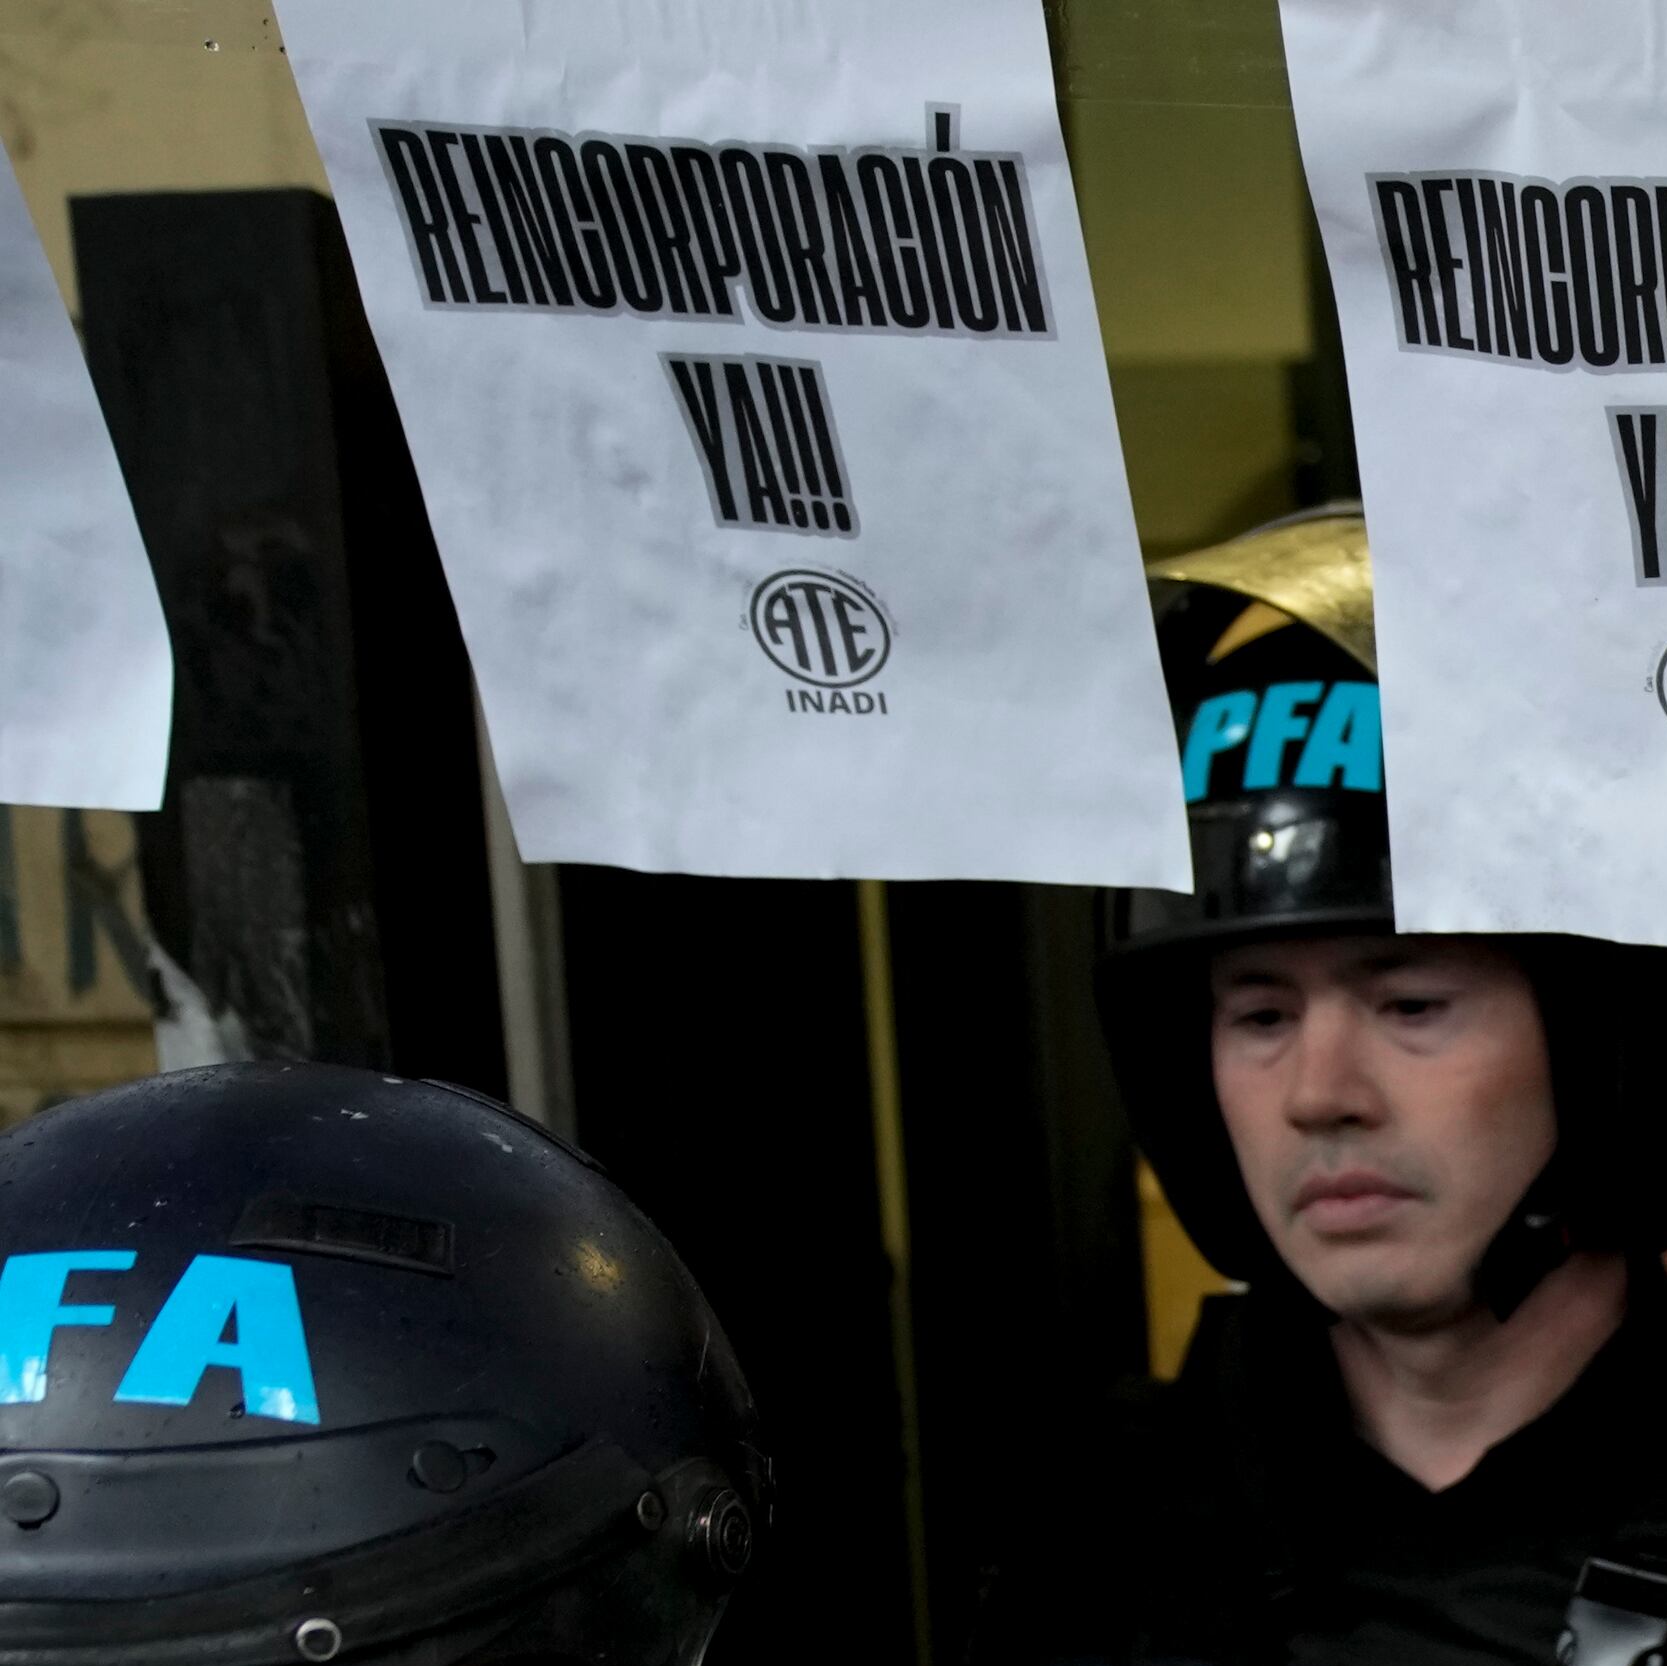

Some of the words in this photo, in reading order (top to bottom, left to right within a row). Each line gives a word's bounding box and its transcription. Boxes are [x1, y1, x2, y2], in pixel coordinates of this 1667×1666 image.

[384, 112, 1048, 334] REINCORPORACIÓN
[669, 359, 852, 533] YA!!!
[764, 581, 876, 677] ATE
[785, 689, 889, 716] INADI
[1182, 682, 1384, 803] PFA
